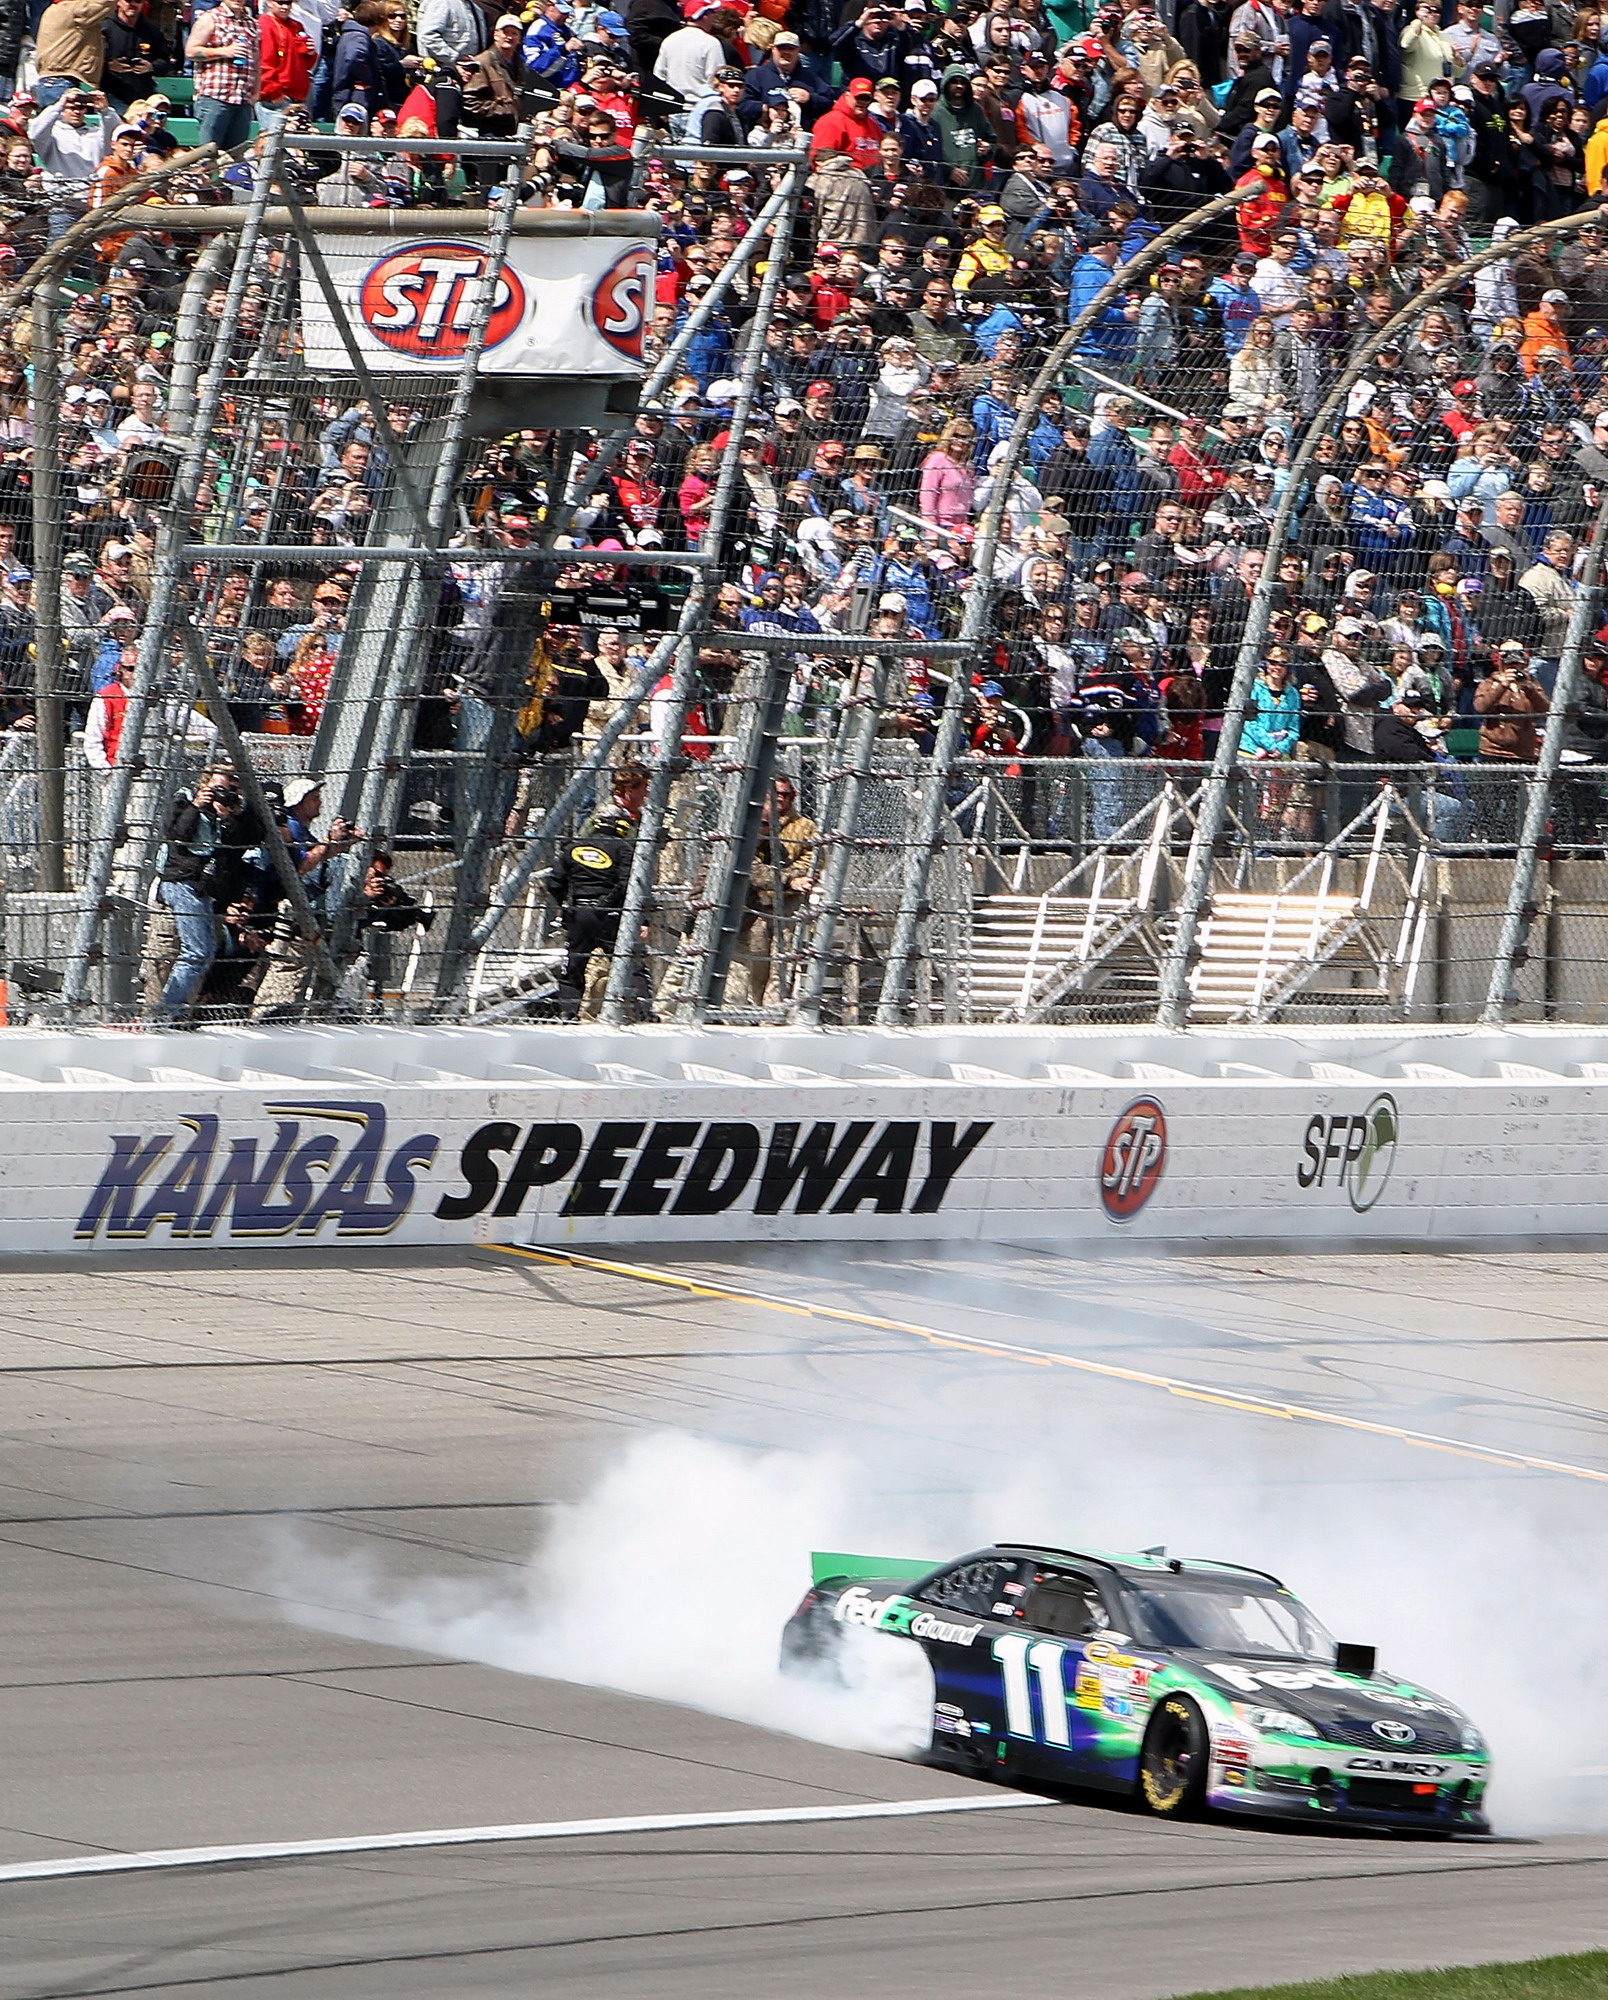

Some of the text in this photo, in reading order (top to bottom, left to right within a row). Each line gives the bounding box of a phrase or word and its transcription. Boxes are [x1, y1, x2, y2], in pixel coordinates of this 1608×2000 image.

[371, 258, 510, 339] STP
[578, 610, 642, 628] WHELEN
[73, 1101, 994, 1239] KANSAS SPEEDWAY
[1102, 1116, 1163, 1198] STP
[1297, 1113, 1367, 1189] SFP
[989, 1630, 1074, 1752] 11
[1345, 1757, 1452, 1778] CAMRY
